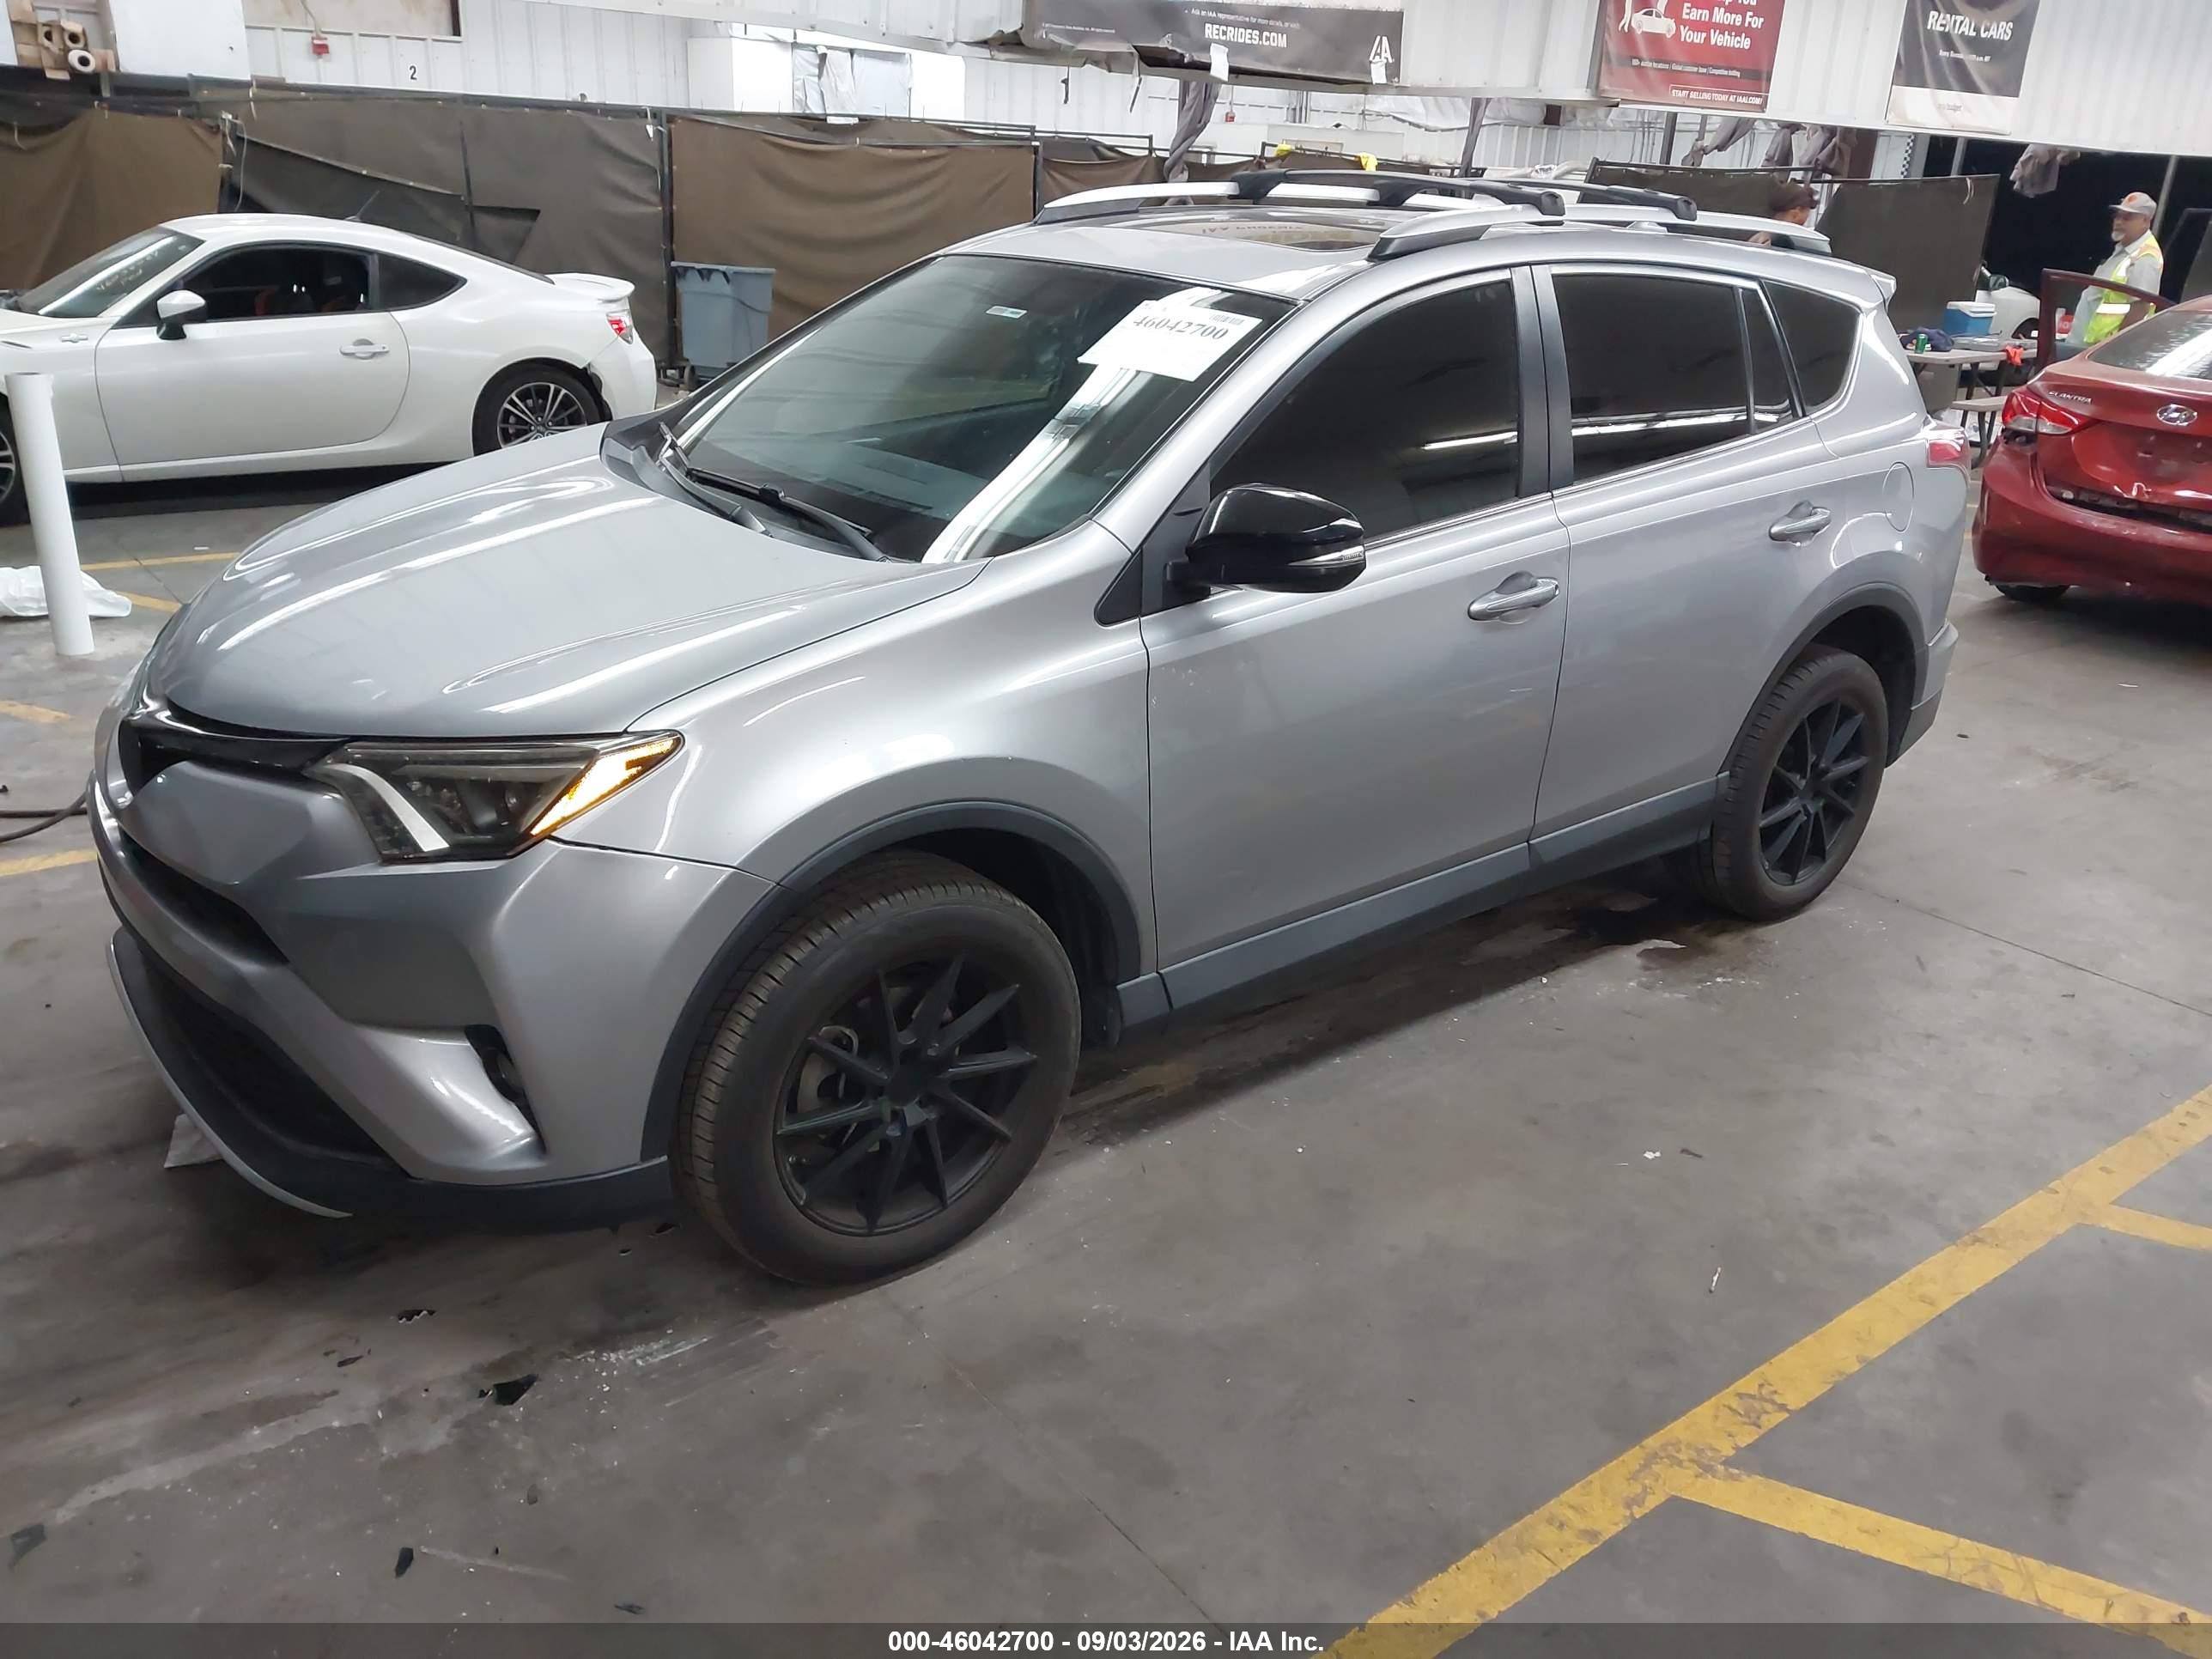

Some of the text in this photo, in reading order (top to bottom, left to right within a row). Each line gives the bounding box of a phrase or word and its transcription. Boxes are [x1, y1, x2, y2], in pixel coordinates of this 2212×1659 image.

[1683, 3, 1765, 29] Earn More For
[1927, 10, 2014, 41] RENTAL CARS
[1204, 22, 1287, 48] RECRIDES.COM
[1679, 25, 1751, 50] Your Vehicle
[410, 65, 417, 81] 2
[1133, 315, 1229, 340] 46042700
